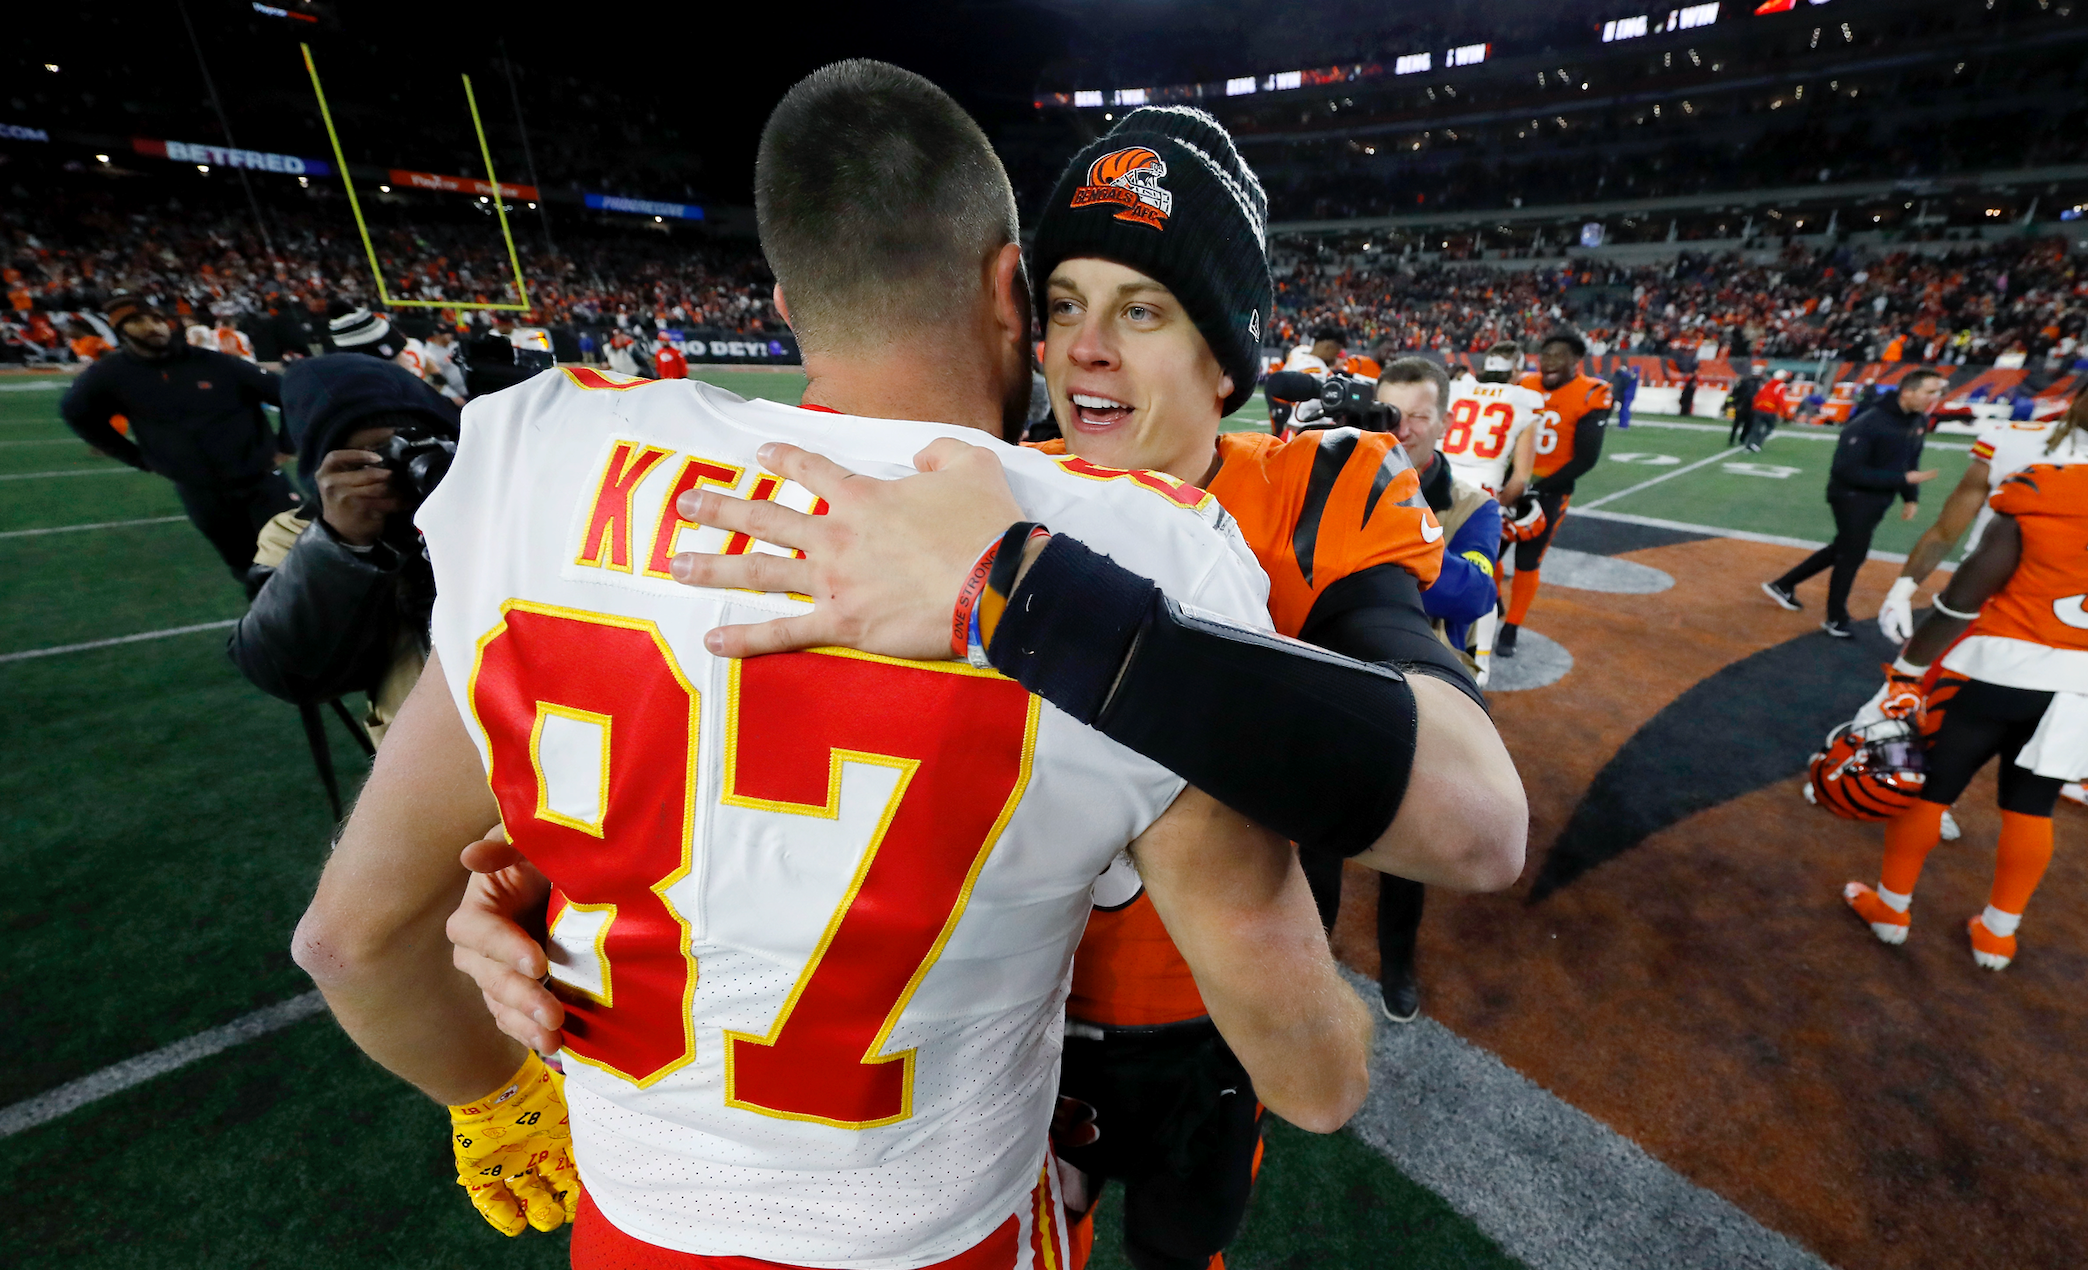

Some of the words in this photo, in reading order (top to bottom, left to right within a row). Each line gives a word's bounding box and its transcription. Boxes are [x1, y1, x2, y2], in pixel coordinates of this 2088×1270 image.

[165, 140, 306, 175] BETFRED
[1075, 187, 1133, 204] BENGALS
[1131, 205, 1159, 220] AFC
[709, 340, 768, 357] DEY!
[1473, 386, 1505, 398] GRAY
[1442, 399, 1515, 460] 83
[954, 610, 966, 640] ONE
[468, 597, 1042, 1131] 87
[515, 1111, 541, 1125] 87
[456, 1132, 473, 1149] 87
[526, 1150, 549, 1168] 87
